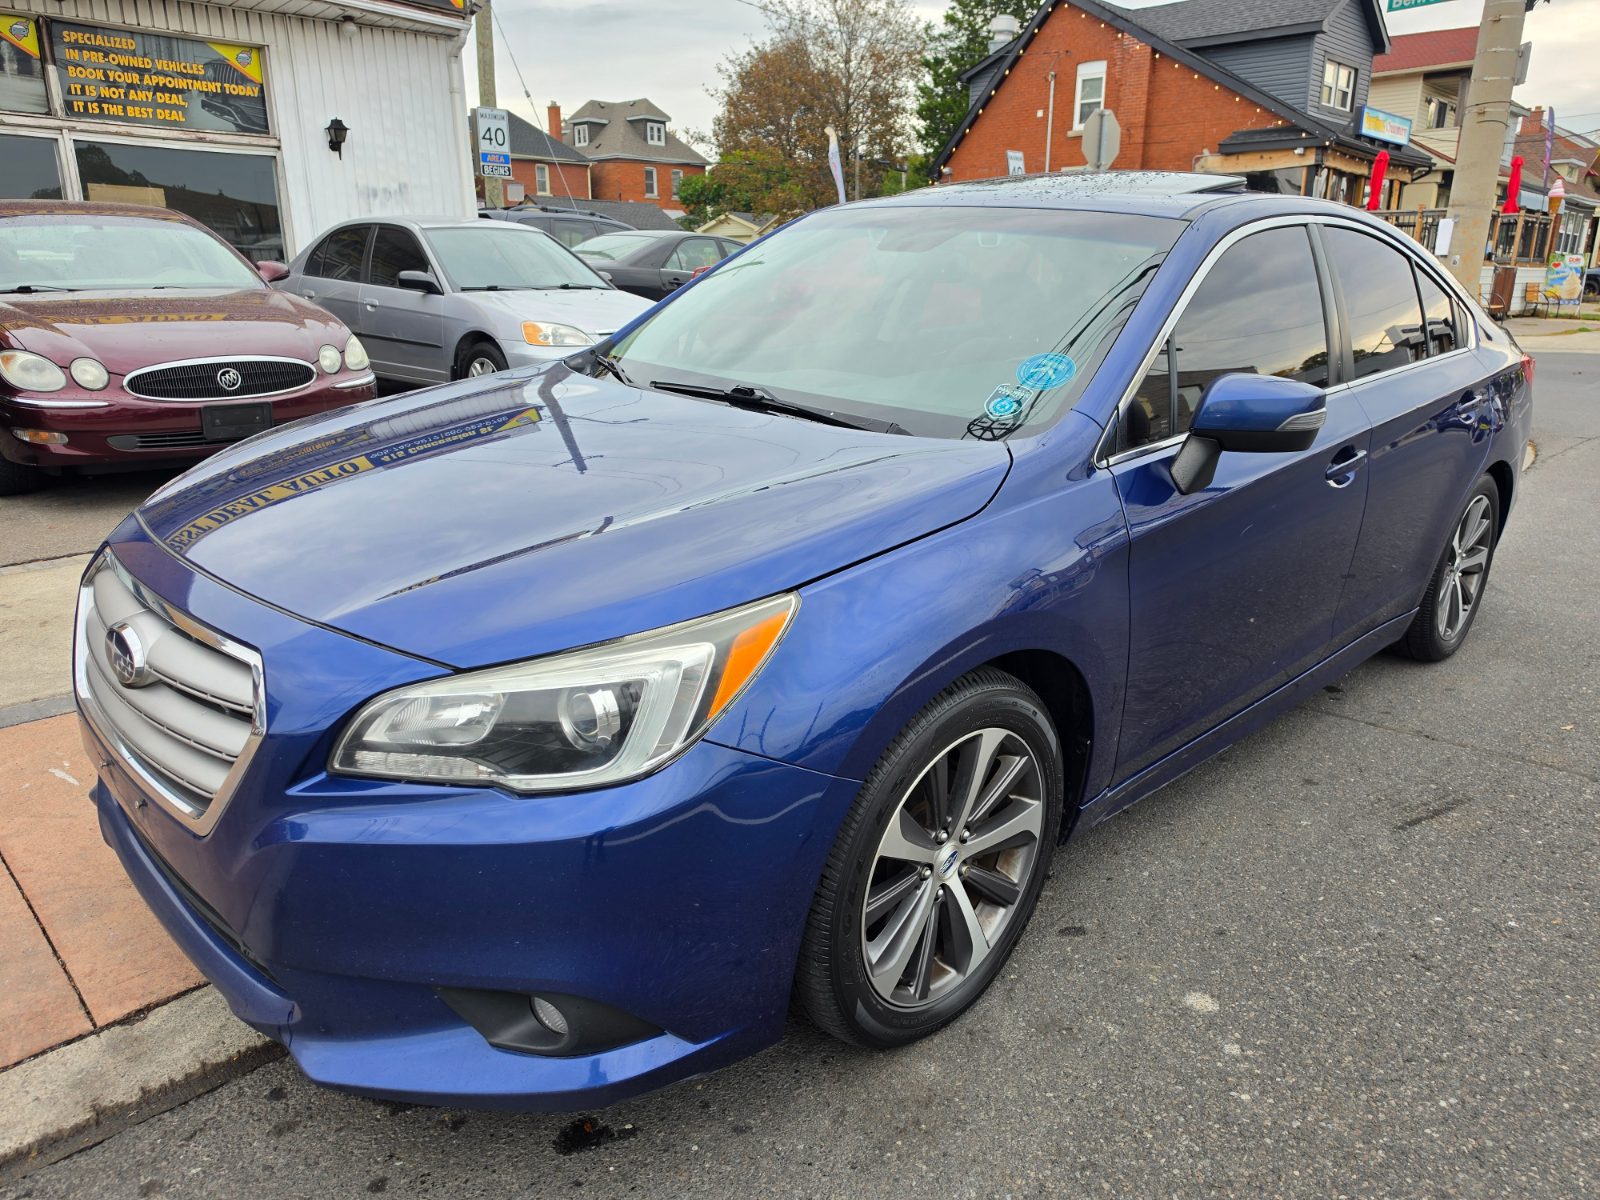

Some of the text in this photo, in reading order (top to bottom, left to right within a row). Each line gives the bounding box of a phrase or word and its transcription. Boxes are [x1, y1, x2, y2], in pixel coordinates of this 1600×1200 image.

[63, 31, 136, 50] SPECIALIZED
[65, 48, 205, 75] IN PRE-OWNED VEHICLES
[68, 65, 259, 97] BOOK YOUR APPOINTMENT TODAY
[70, 83, 188, 108] IT IS NOT ANY DEAL,
[73, 101, 185, 121] IT IS THE BEST DEAL
[481, 126, 506, 146] 40
[483, 165, 510, 176] BEGINS
